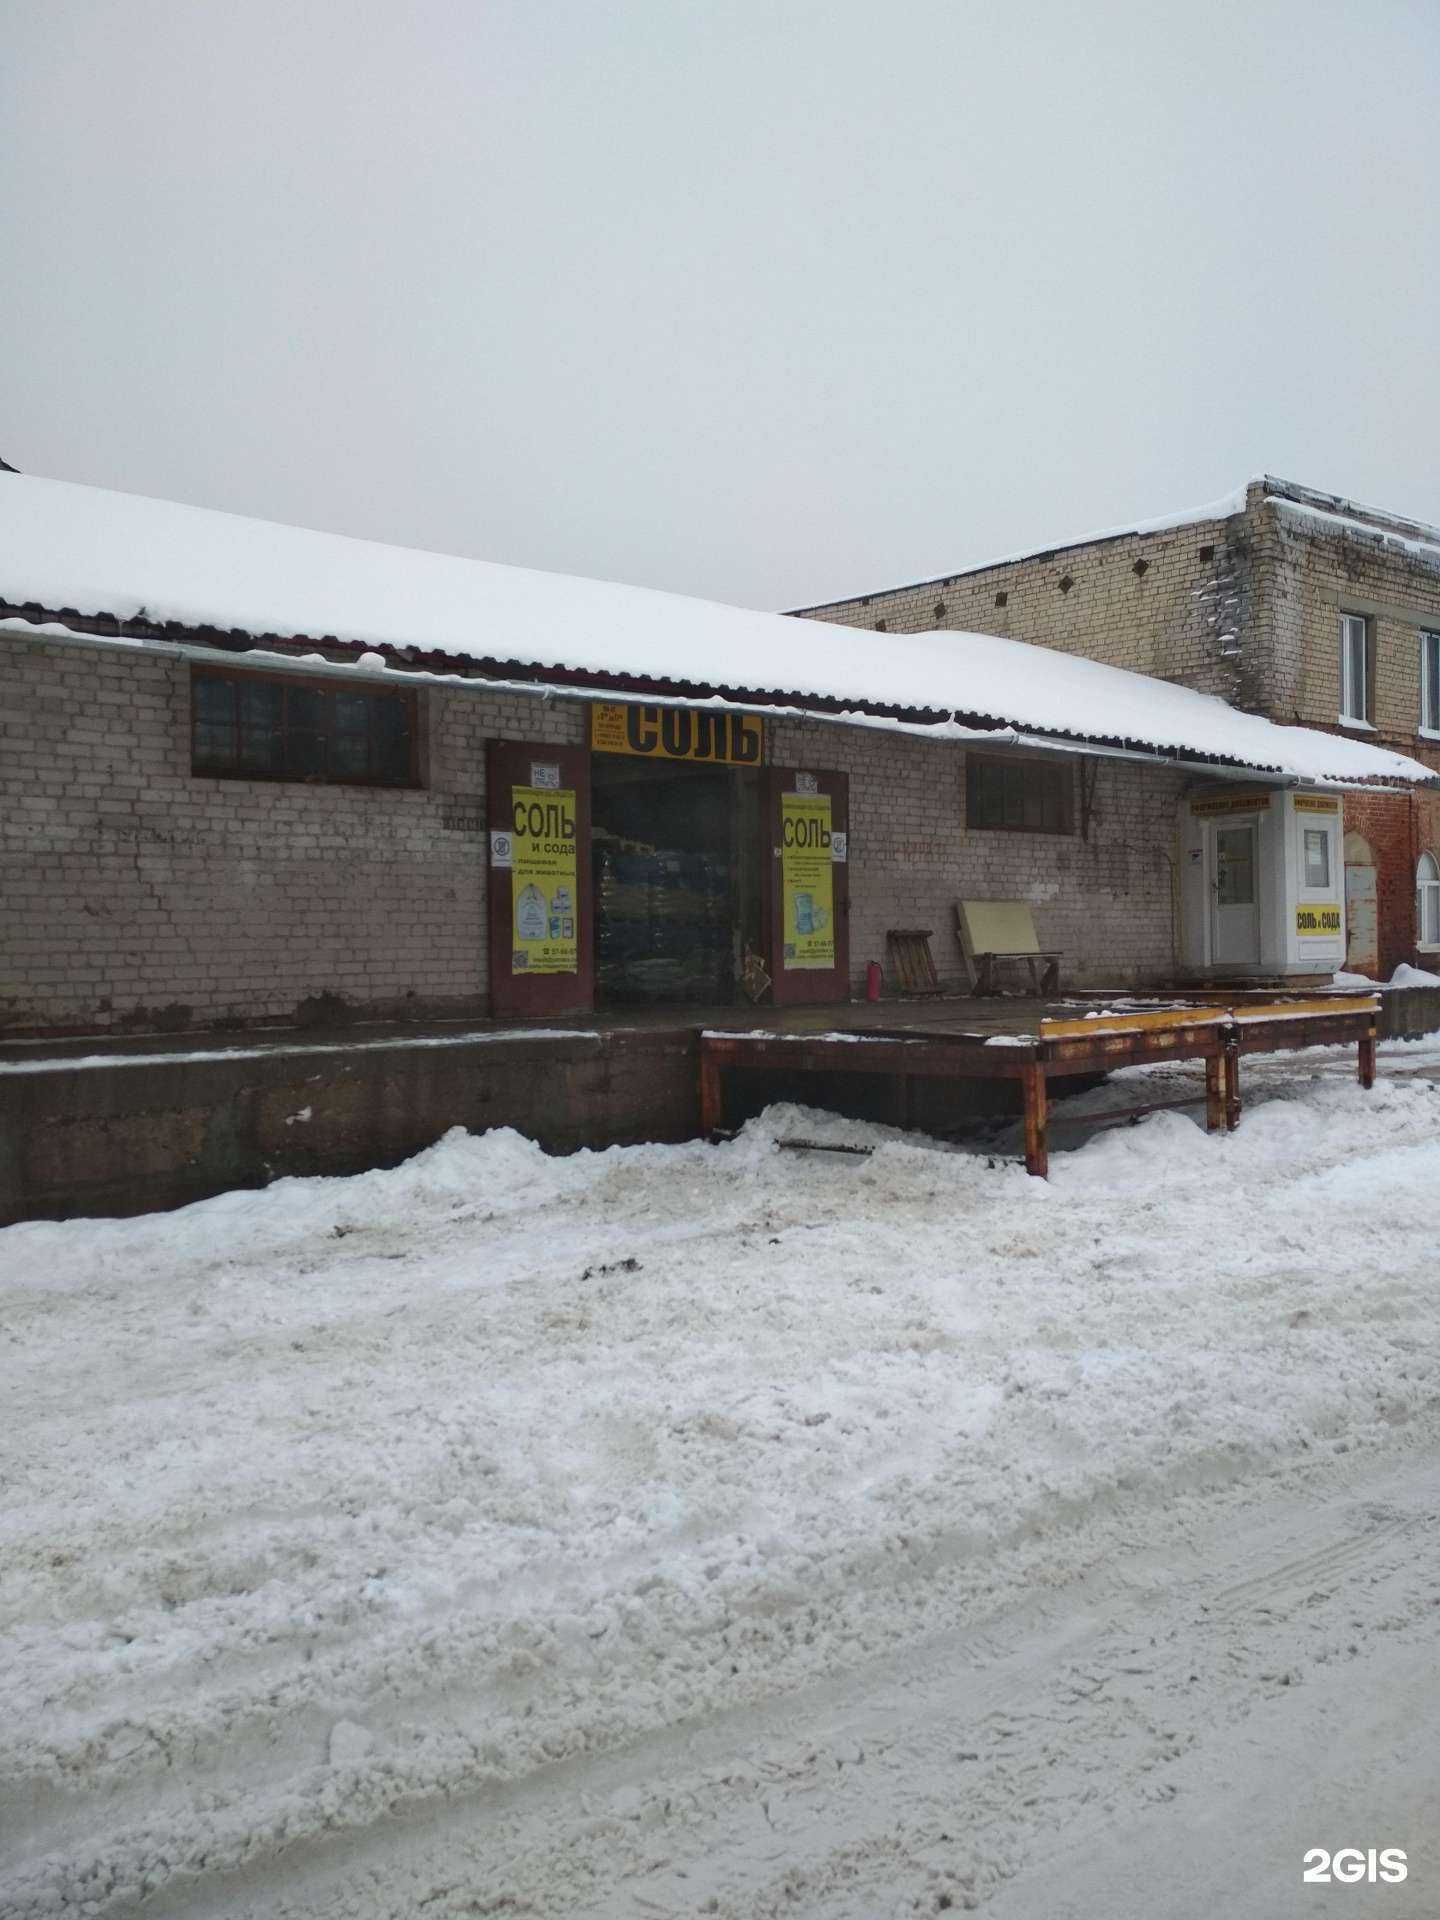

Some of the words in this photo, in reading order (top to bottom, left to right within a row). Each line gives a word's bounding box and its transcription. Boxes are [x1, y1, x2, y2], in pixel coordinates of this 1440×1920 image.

[627, 704, 760, 762] СОЛЬ
[514, 801, 576, 839] СОЛЬ
[784, 817, 831, 848] СОЛЬ
[544, 843, 576, 856] сода
[1297, 912, 1317, 929] СОЛЬ
[1322, 912, 1341, 931] СОДА
